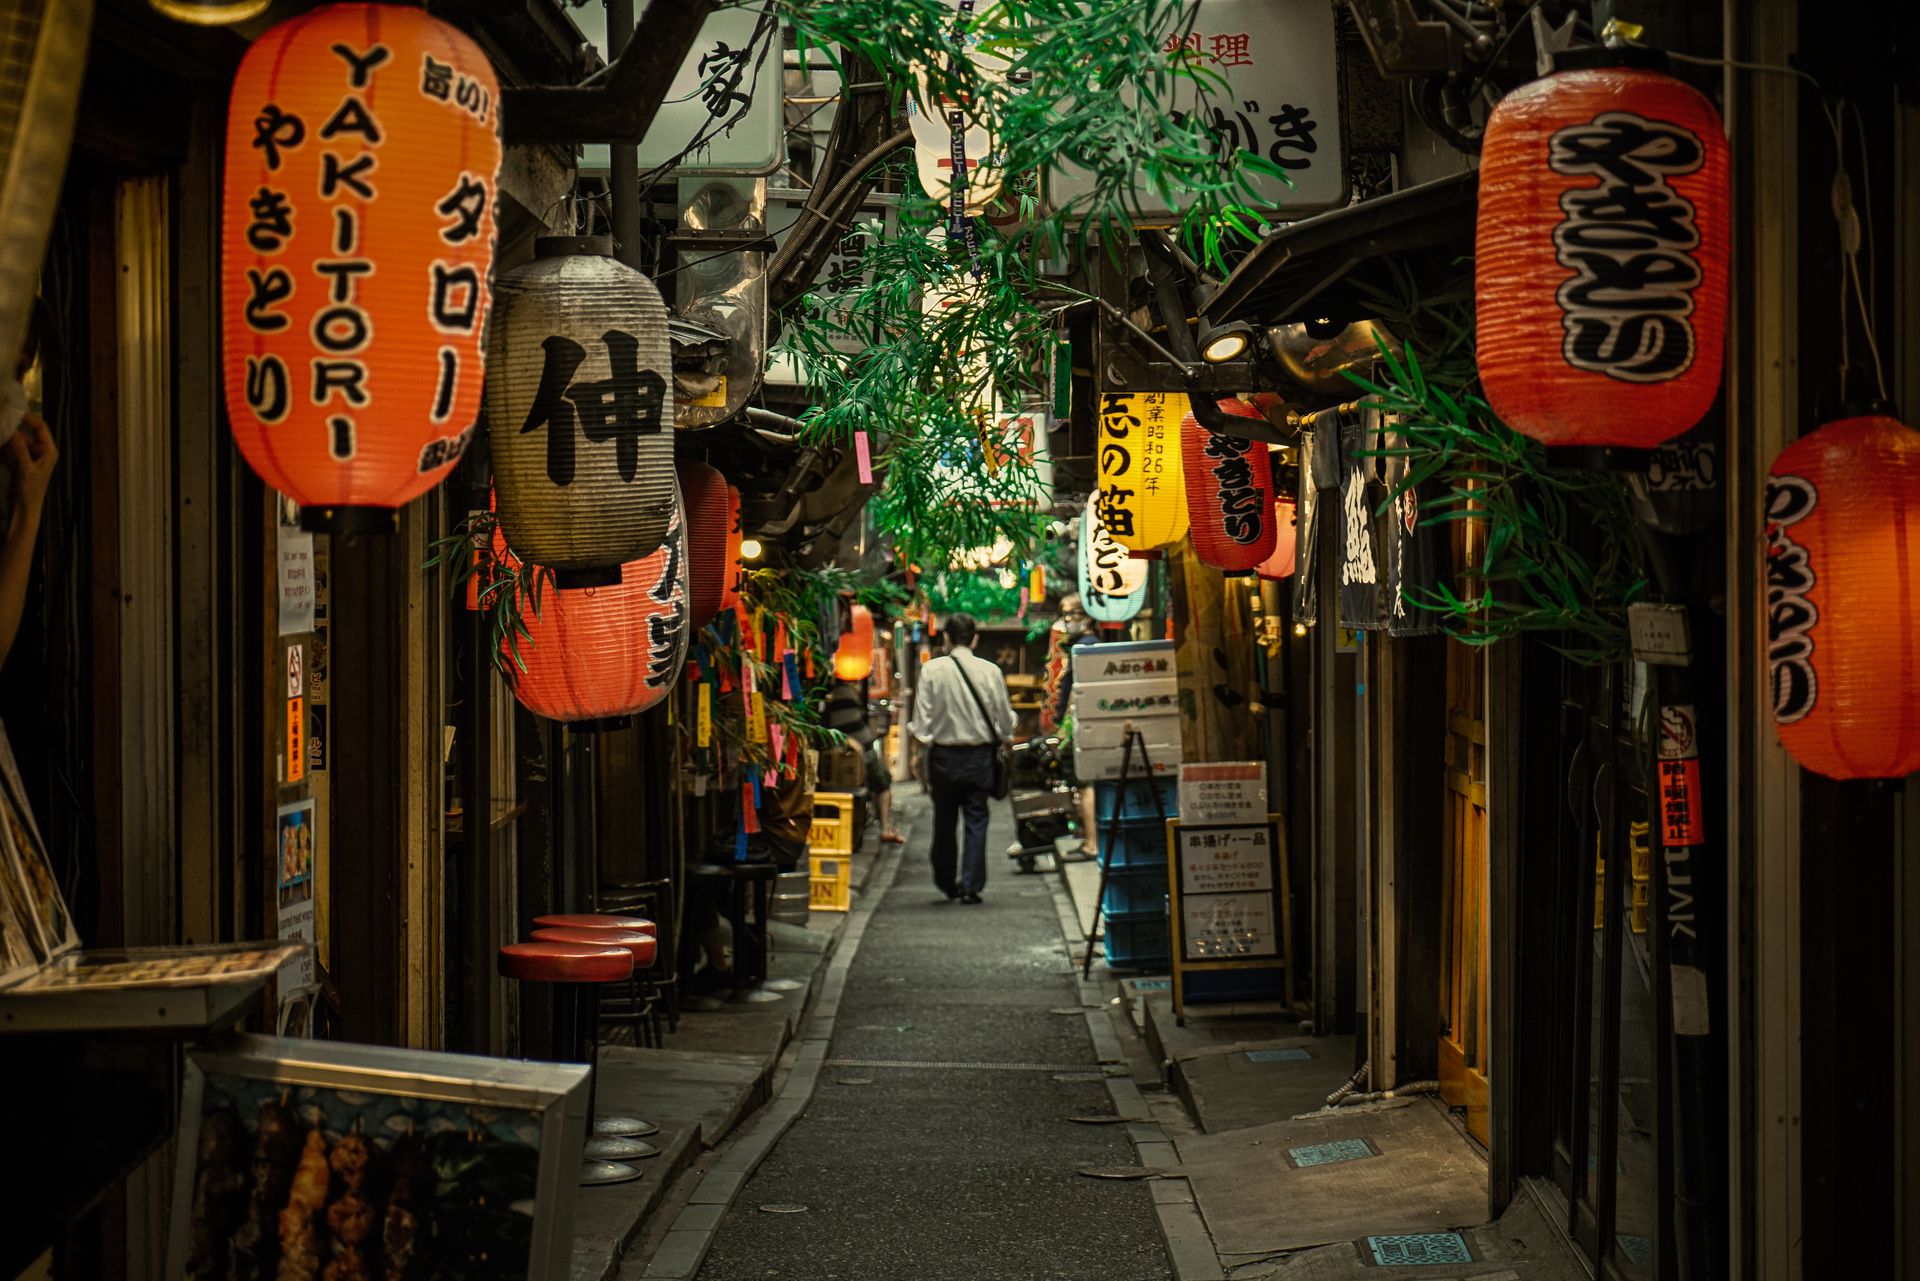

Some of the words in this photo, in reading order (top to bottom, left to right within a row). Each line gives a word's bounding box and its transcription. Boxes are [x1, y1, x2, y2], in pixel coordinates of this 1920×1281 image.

[246, 105, 304, 422] やきとり
[313, 43, 390, 461] YAKITORI
[430, 172, 488, 422] タロー
[1550, 112, 1704, 383] やきとり
[519, 329, 668, 486] 伸
[1203, 434, 1262, 545] やきとり
